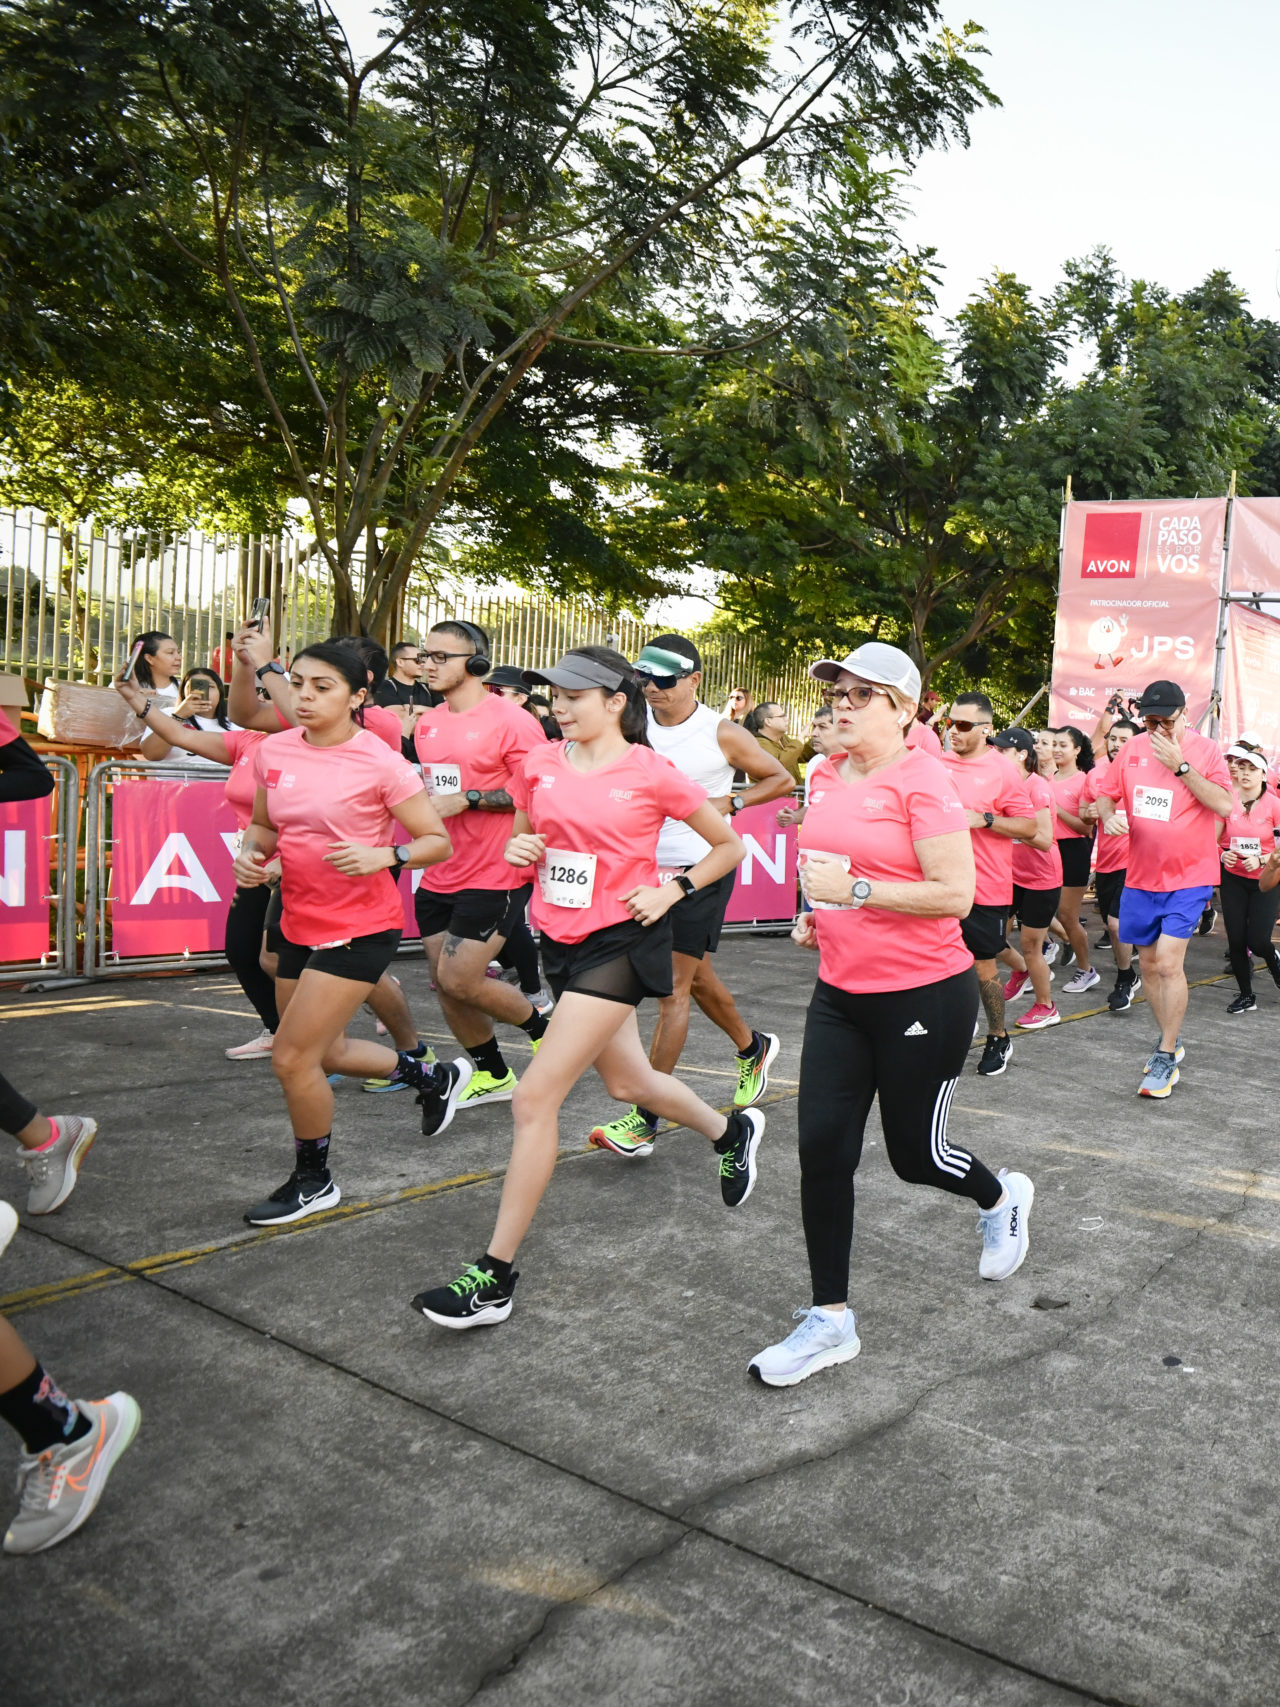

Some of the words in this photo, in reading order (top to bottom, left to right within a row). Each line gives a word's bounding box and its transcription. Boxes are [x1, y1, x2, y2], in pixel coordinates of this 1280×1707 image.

[1159, 516, 1201, 530] CADA
[1157, 530, 1202, 545] PASO
[1157, 545, 1170, 553] ES
[1175, 545, 1201, 554] POR
[1086, 560, 1131, 573] AVON
[1156, 554, 1200, 574] VOS
[1090, 600, 1142, 608] PATROCINADOR
[1143, 600, 1170, 608] OFICIAL
[1130, 635, 1195, 660] JPS
[1078, 687, 1095, 696] BAC
[435, 776, 458, 786] 1940
[1145, 795, 1169, 808] 2095
[550, 865, 588, 885] 1286
[1009, 1205, 1018, 1237] HOKA
